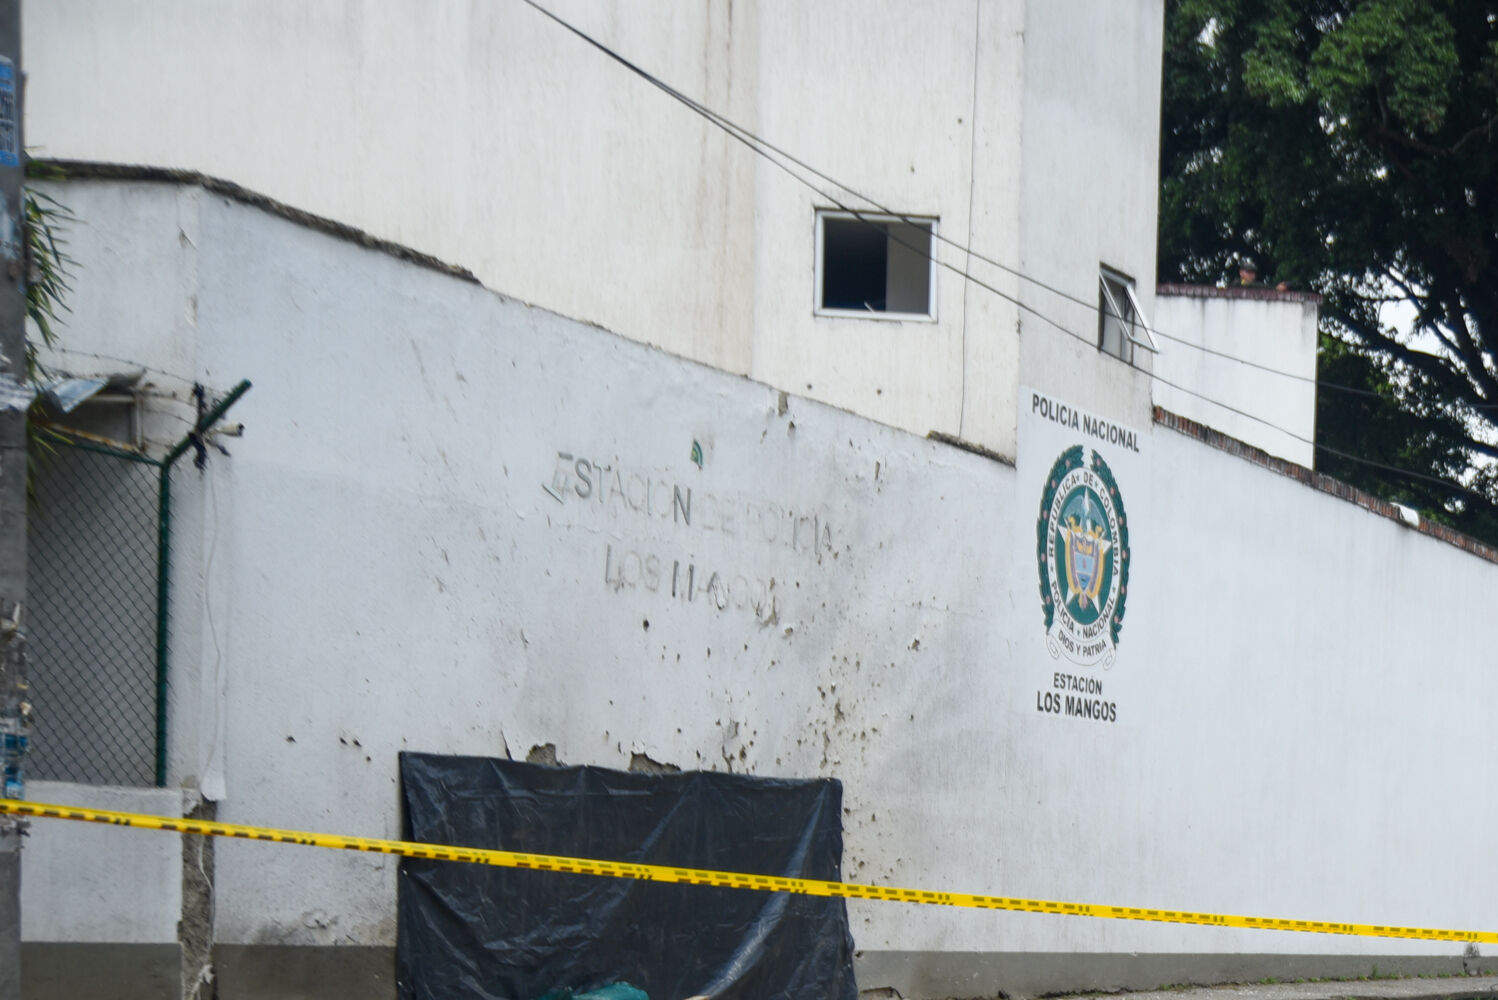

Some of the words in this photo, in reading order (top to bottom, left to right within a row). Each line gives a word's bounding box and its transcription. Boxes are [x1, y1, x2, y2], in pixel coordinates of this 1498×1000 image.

[1032, 393, 1079, 431] POLICIA
[1083, 413, 1139, 453] NACIONAL
[1083, 471, 1094, 487] DE
[1099, 487, 1119, 576] COLOMBIA
[1051, 580, 1075, 633] POLICIA
[1082, 596, 1115, 639] NACIONAL
[1058, 630, 1075, 653] DIOS
[1076, 645, 1082, 657] Y
[1082, 640, 1107, 657] PATRIA
[1037, 690, 1061, 714] LOS
[1065, 695, 1117, 723] MANGOS
